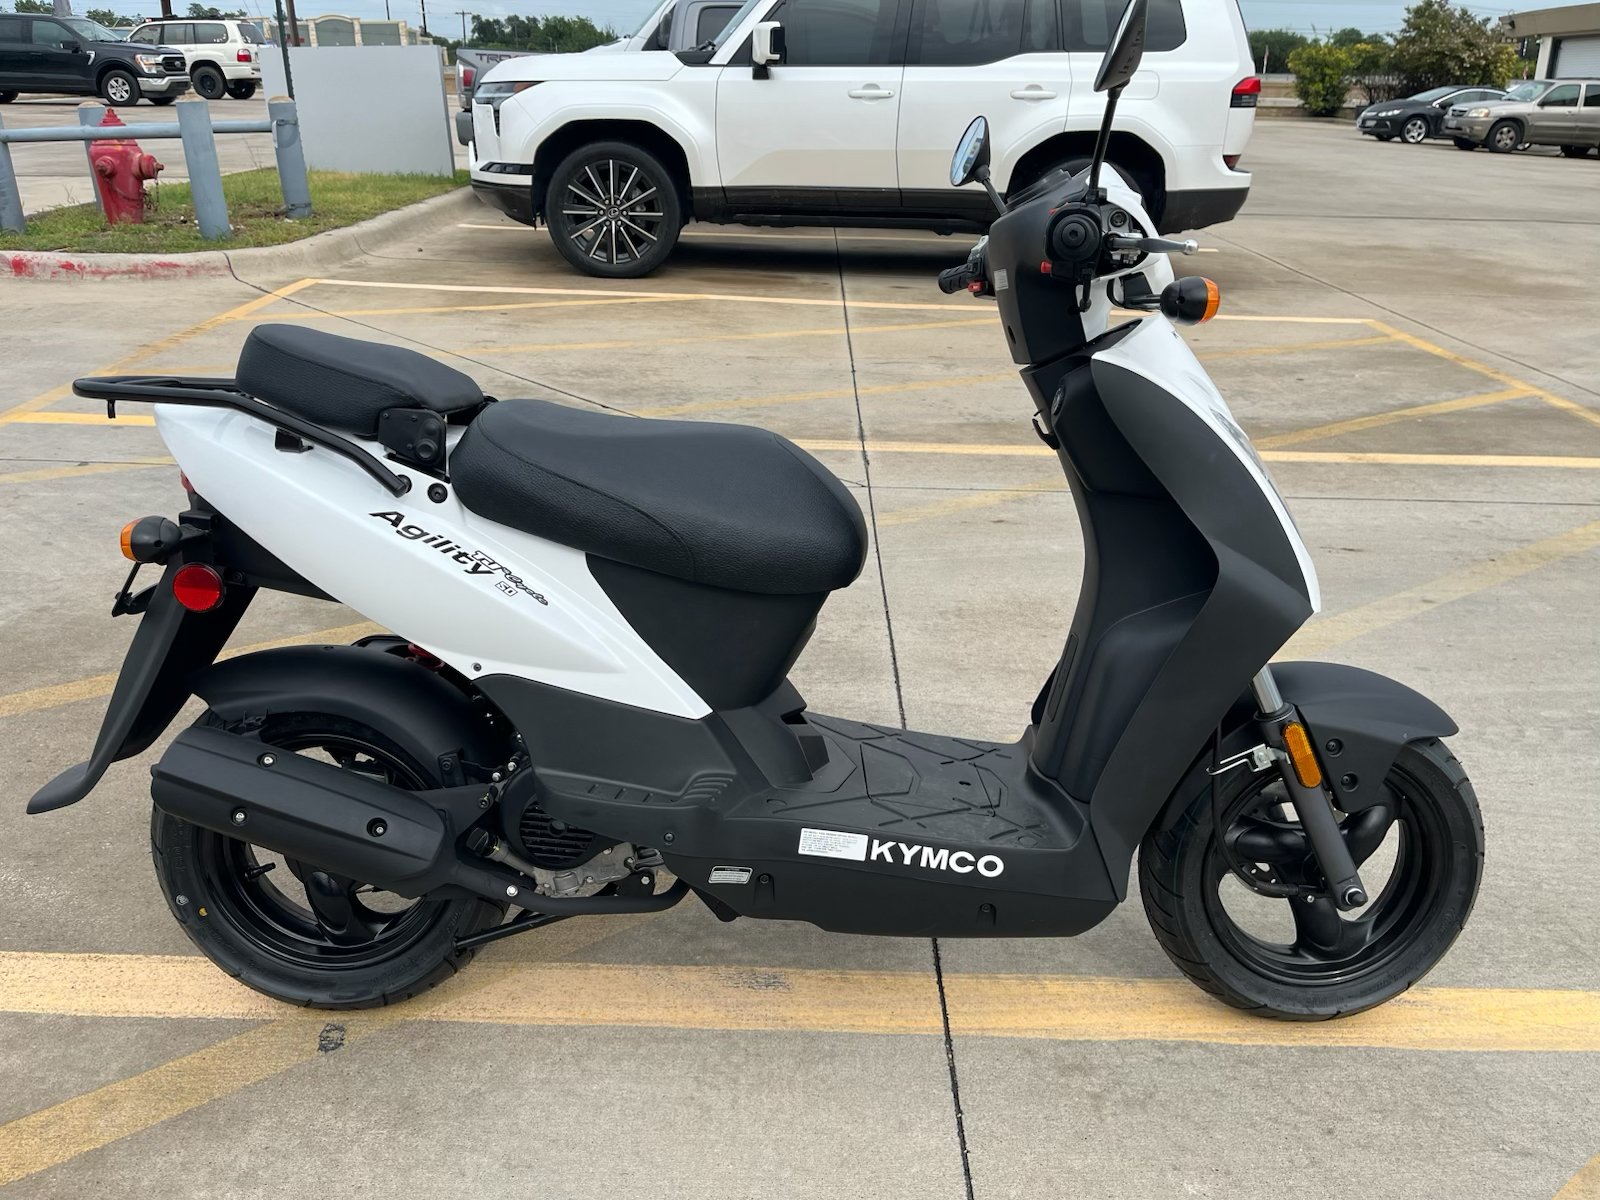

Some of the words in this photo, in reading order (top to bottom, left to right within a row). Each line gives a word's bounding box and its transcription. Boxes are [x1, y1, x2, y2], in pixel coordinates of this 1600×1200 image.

[368, 511, 495, 574] Agility
[495, 581, 518, 597] 50
[870, 839, 1004, 878] KYMCO
